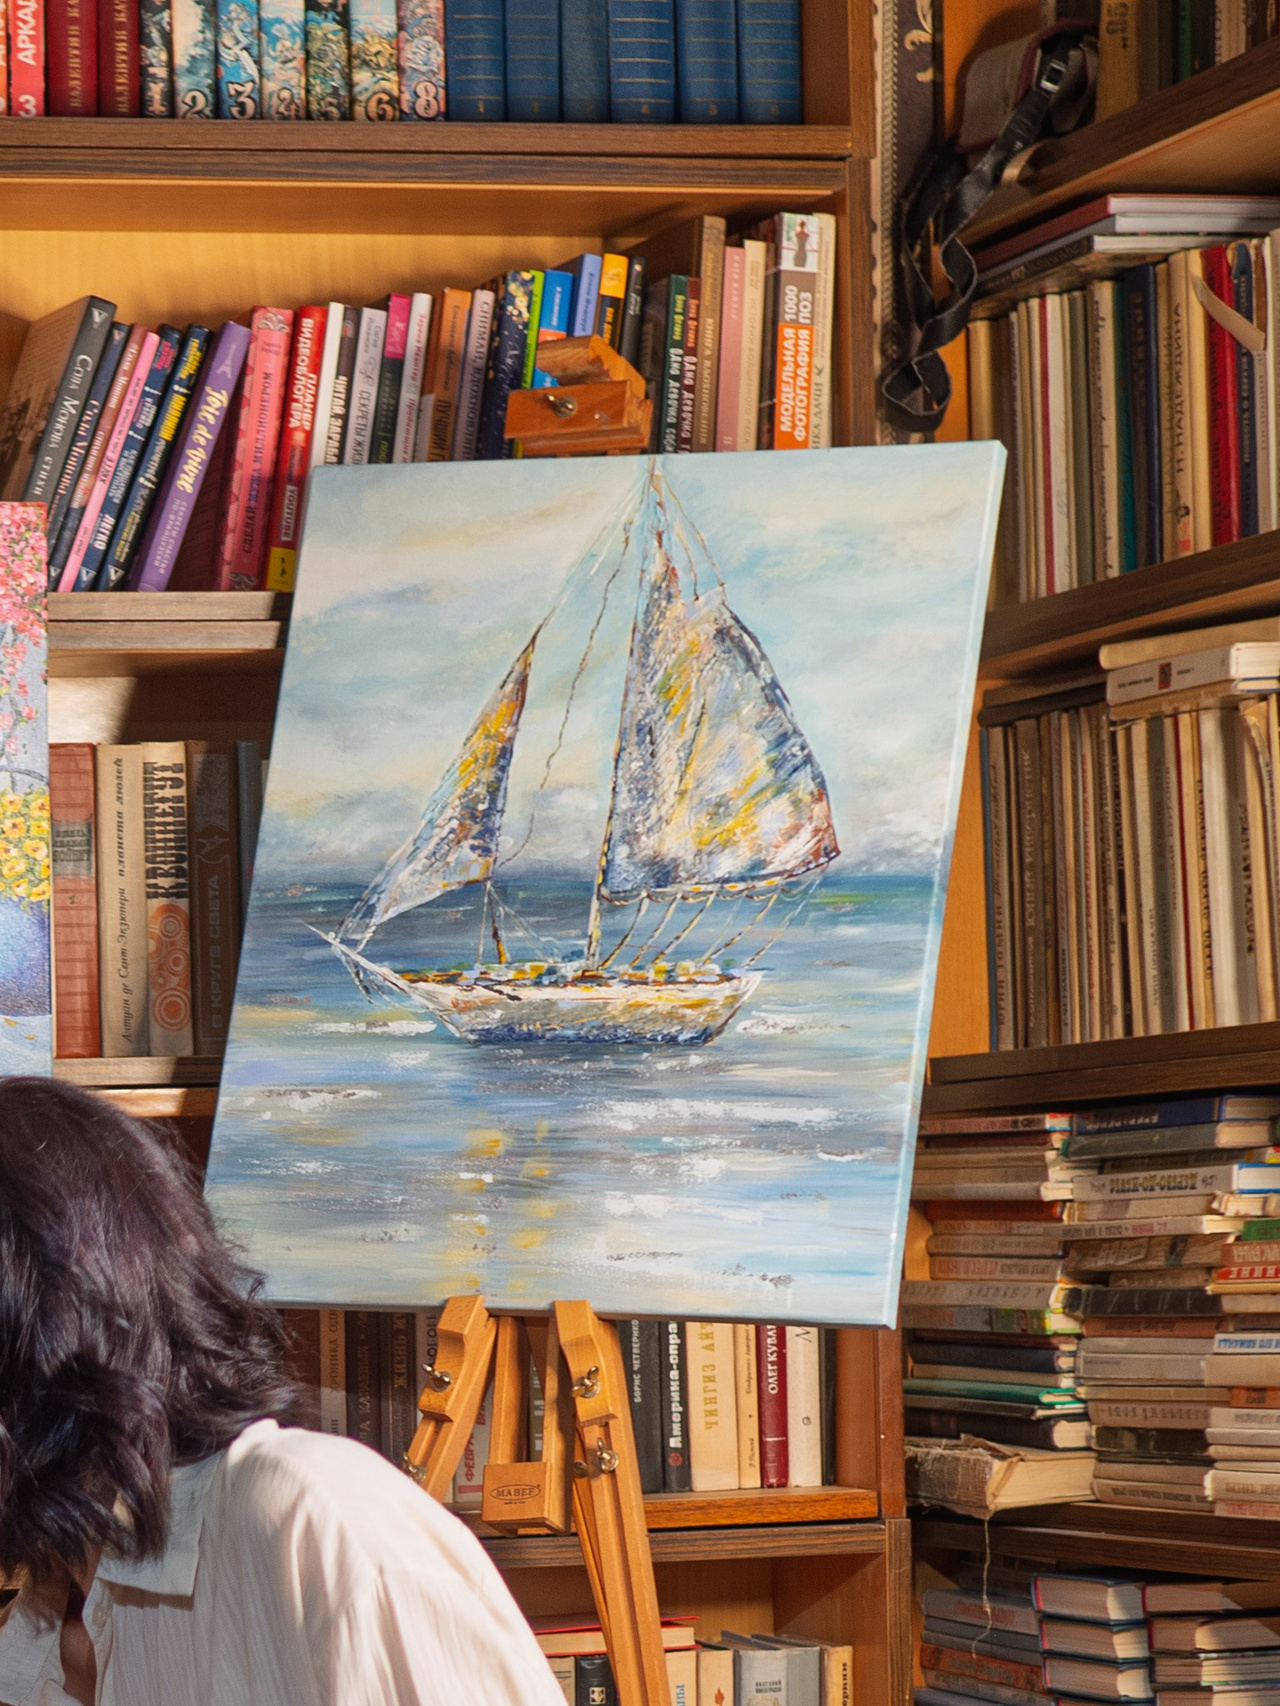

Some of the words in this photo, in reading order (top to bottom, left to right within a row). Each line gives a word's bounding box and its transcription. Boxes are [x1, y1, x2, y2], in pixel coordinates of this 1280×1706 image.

[18, 95, 36, 117] 3
[182, 90, 206, 119] 2
[228, 79, 256, 120] 3
[366, 92, 393, 121] 6
[414, 81, 440, 119] 8
[784, 285, 798, 322] 1000
[798, 291, 812, 323] ПОЗ
[289, 318, 314, 429] ВИДЕОБЛОГЕРА
[780, 327, 797, 432] МОДЕЛЬНАЯ
[794, 328, 811, 441] ФОТОГРАФИЯ
[302, 373, 318, 431] ПЛАНЕР
[356, 390, 371, 436] СЕКРЕТЫ
[243, 506, 258, 553] СДЕЛАЙ
[252, 372, 273, 466] МИЛЛИОНЕРОМ
[701, 1364, 719, 1430] ЧИНГИЗ
[767, 1364, 778, 1394] ОЛЕГ
[495, 1486, 539, 1500] MABEF
